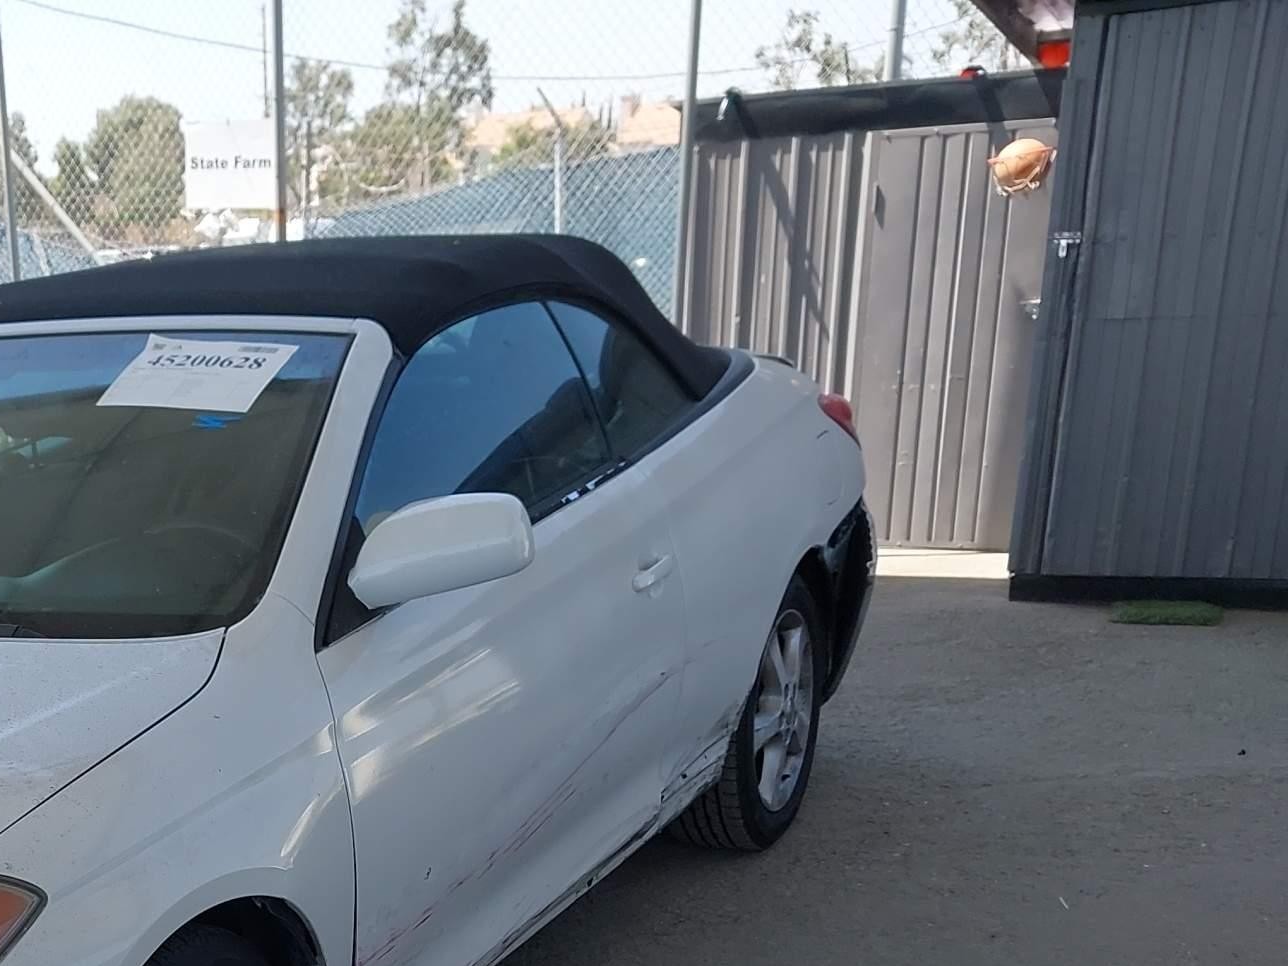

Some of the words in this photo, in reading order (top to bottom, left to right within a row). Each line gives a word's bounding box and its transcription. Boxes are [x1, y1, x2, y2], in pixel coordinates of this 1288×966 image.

[191, 157, 228, 170] State
[234, 156, 271, 169] Farm
[147, 354, 267, 369] 45200628
